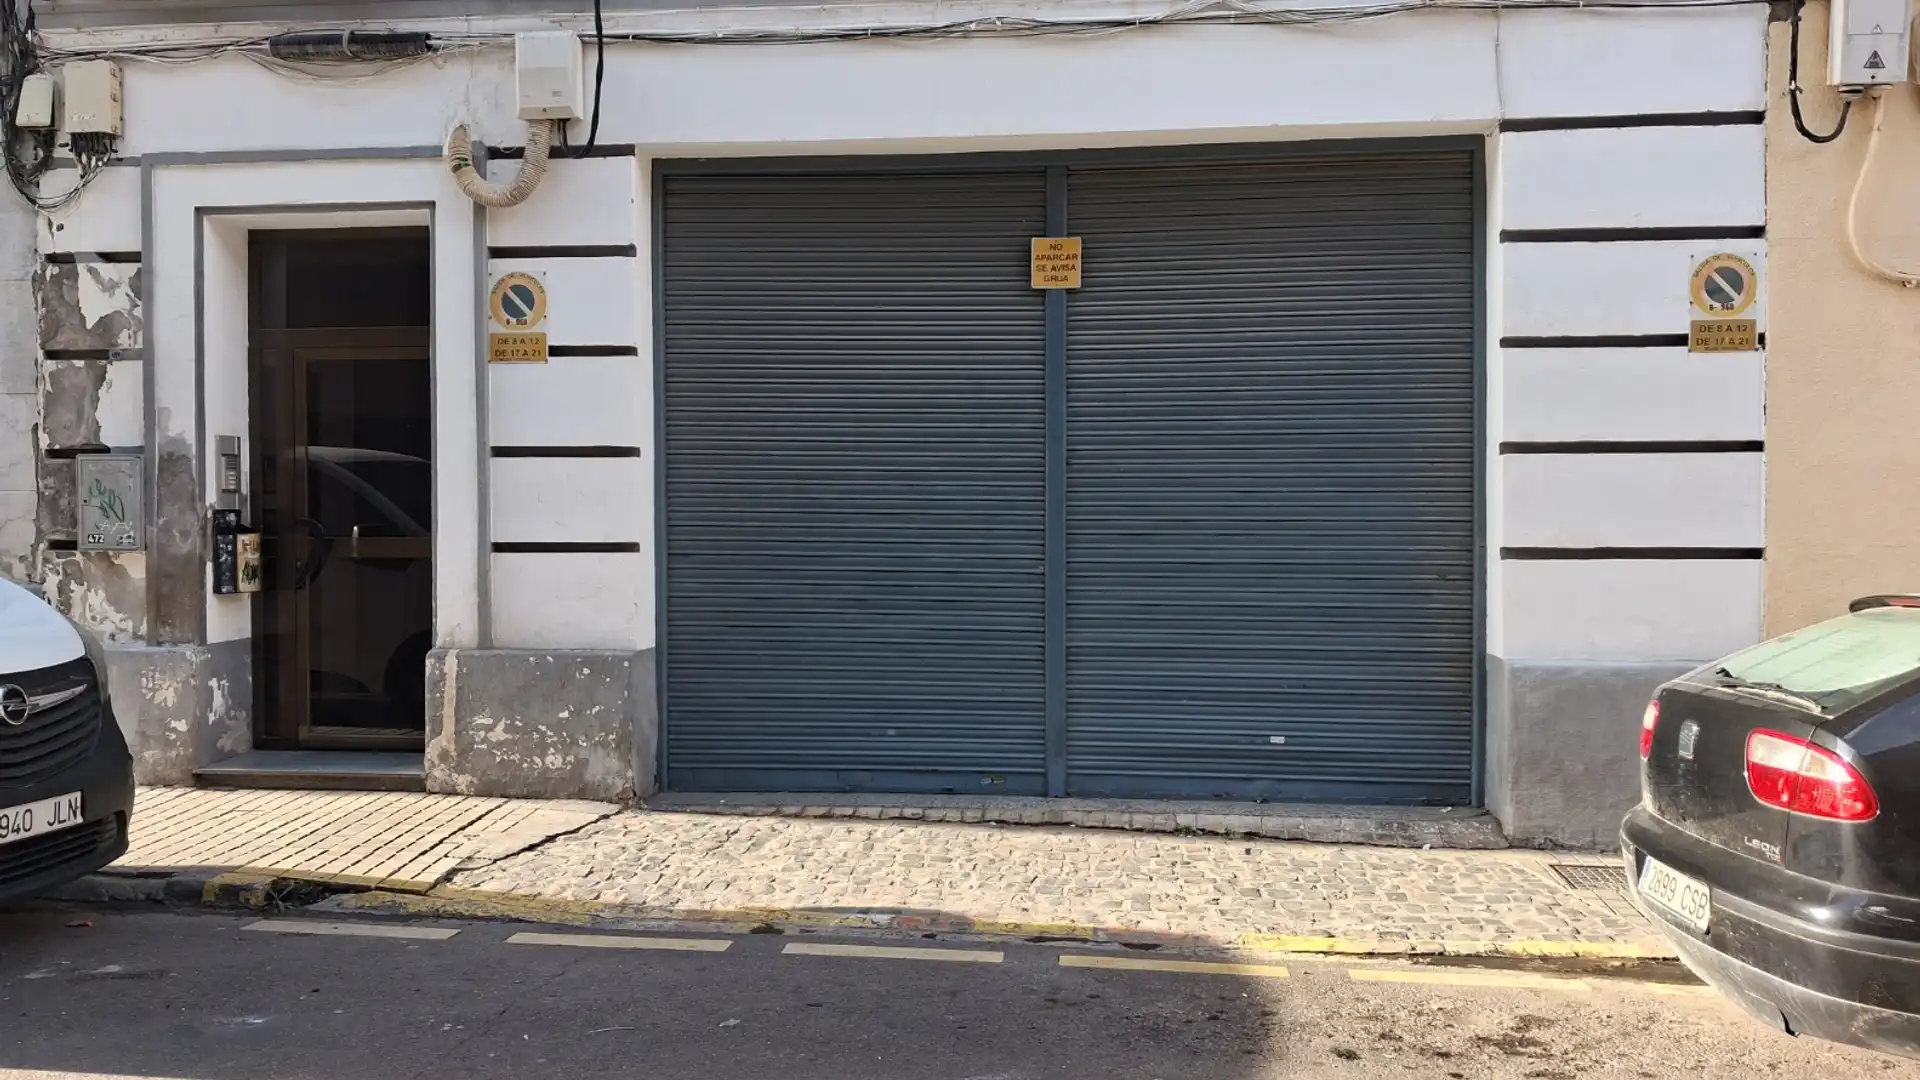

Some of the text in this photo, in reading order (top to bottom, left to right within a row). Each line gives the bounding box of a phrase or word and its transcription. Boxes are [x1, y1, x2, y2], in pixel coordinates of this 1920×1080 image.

[1049, 243, 1064, 251] NO
[1035, 253, 1079, 261] APARCAR
[1035, 263, 1077, 272] SE AVISA
[1043, 274, 1069, 282] GRUA
[1699, 324, 1715, 333] DE
[1725, 324, 1733, 333] A
[1736, 324, 1748, 333] 12
[497, 337, 510, 345] DE
[519, 337, 527, 345] A
[530, 337, 541, 345] 12
[1696, 337, 1749, 346] DE 17 A 21
[494, 349, 541, 358] DE 17 A 21
[47, 796, 79, 826] JLN
[1743, 836, 1781, 855] LEON
[1648, 865, 1709, 920] 2899 CSB
